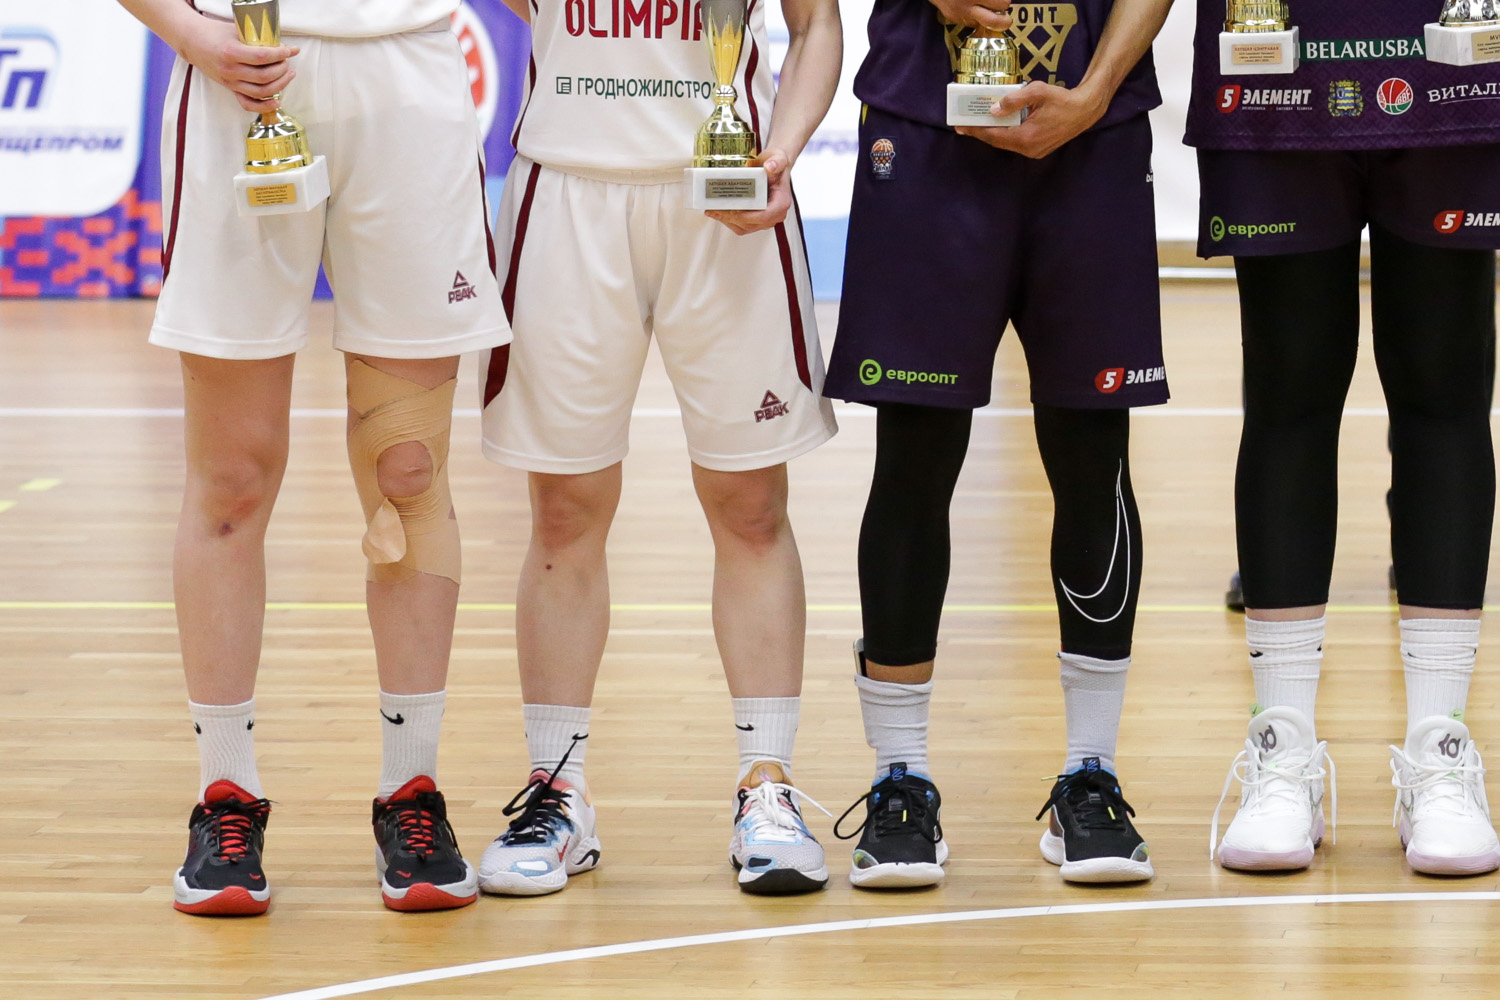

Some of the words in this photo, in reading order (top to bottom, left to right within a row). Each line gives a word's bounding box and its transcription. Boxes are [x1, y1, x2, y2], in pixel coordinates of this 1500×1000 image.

[577, 77, 716, 101] ГРОДНОЖИЛСТРО
[1221, 88, 1235, 108] 5
[1241, 89, 1312, 105] ЭЛЕМЕНТ
[1227, 221, 1297, 239] евроопт
[1441, 213, 1456, 230] 5
[447, 285, 478, 304] PEAK
[885, 368, 959, 385] евроопт
[1102, 371, 1117, 389] 5
[753, 401, 790, 423] PEAK
